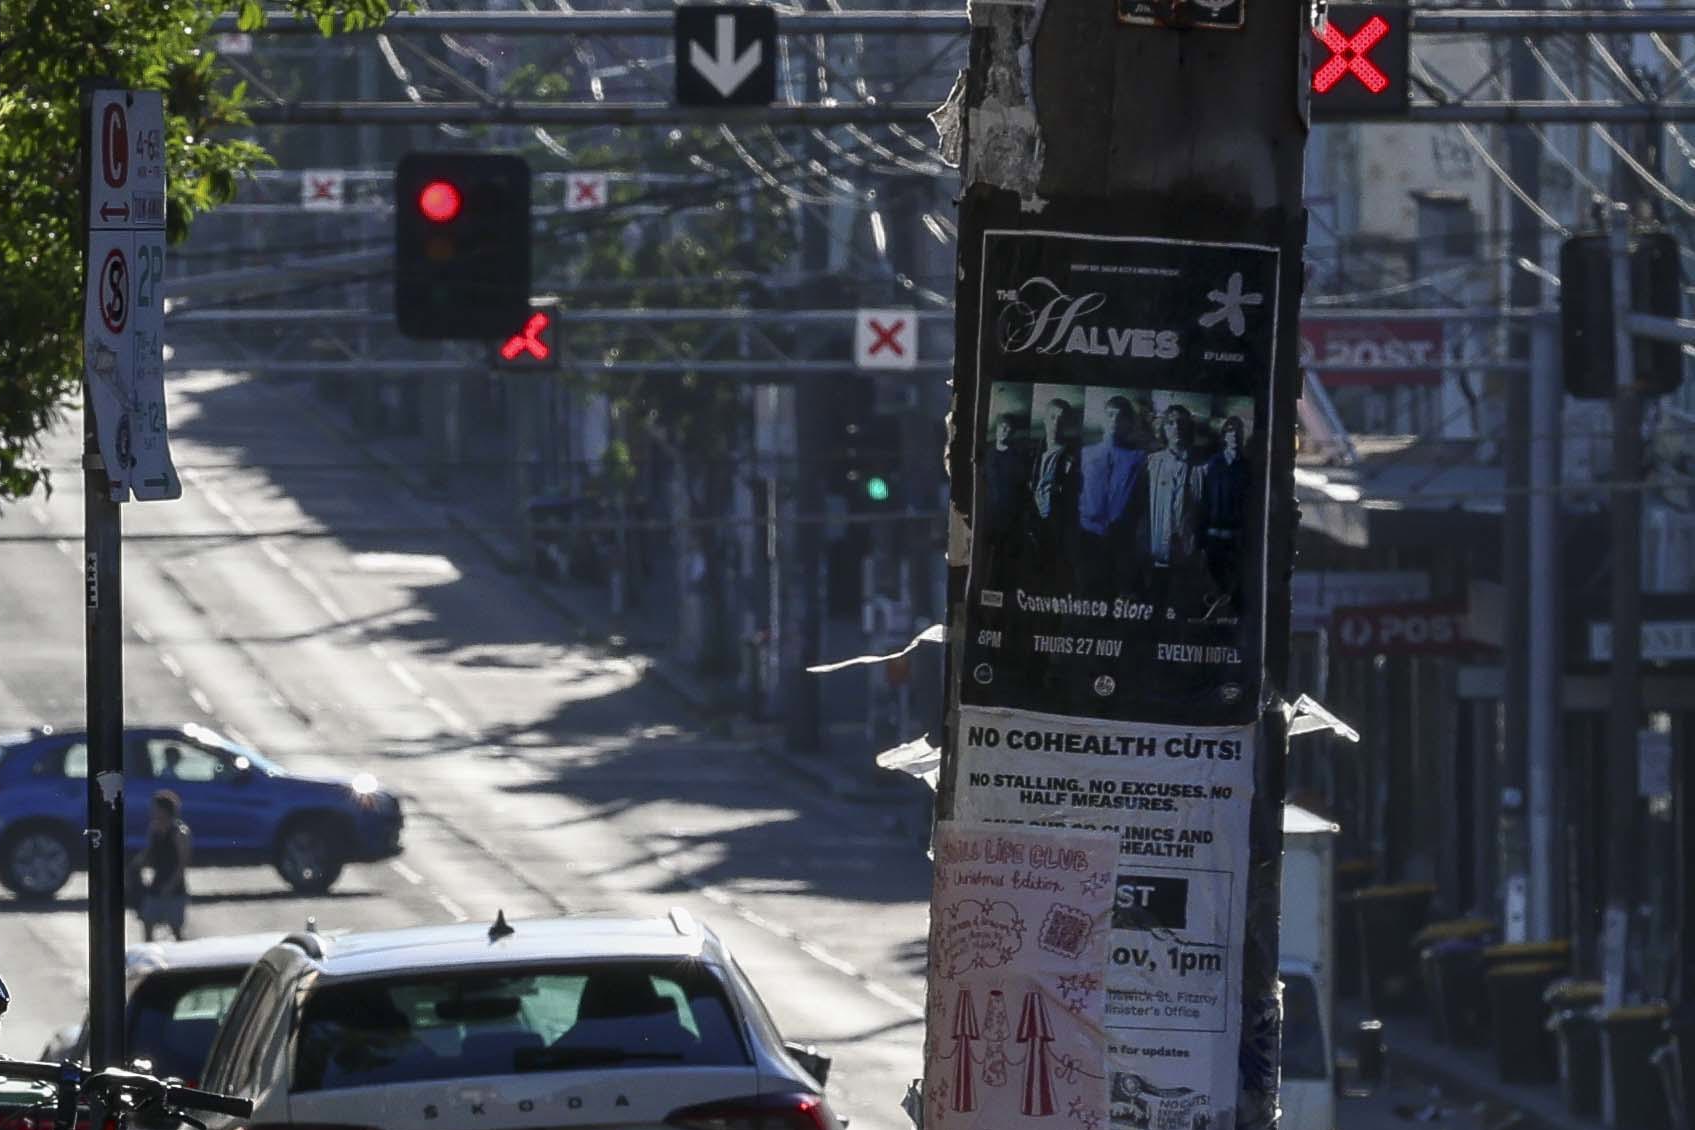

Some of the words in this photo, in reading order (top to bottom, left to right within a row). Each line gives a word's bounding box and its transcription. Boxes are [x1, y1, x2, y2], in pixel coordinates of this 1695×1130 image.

[996, 289, 1017, 301] THE
[998, 276, 1181, 360] HALVES
[1016, 589, 1108, 617] Convenience
[1112, 597, 1154, 621] Store
[1033, 635, 1073, 655] THURS
[1076, 637, 1094, 655] 27
[1096, 639, 1123, 657] NOV
[1157, 643, 1203, 664] EVELYN
[1205, 645, 1242, 665] HOTEL
[968, 727, 999, 749] NO
[1006, 729, 1156, 758] COHEALTH
[1165, 736, 1242, 761] CUTS!
[969, 773, 990, 787] NO
[994, 774, 1084, 793] STALLING.
[1089, 780, 1116, 794] NO
[1121, 782, 1208, 799] EXCUSES.
[1211, 787, 1233, 800] NO
[1020, 790, 1069, 806] HALF
[1071, 793, 1179, 812] MEASURES.
[1178, 830, 1213, 844] AND
[1029, 845, 1089, 872] CLUB
[1108, 946, 1157, 971] ov,
[1167, 947, 1222, 977] 1pm
[1165, 1006, 1201, 1019] Office
[1177, 992, 1218, 1006] Fitzroy
[1121, 1044, 1139, 1055] for
[1142, 1045, 1191, 1058] updates
